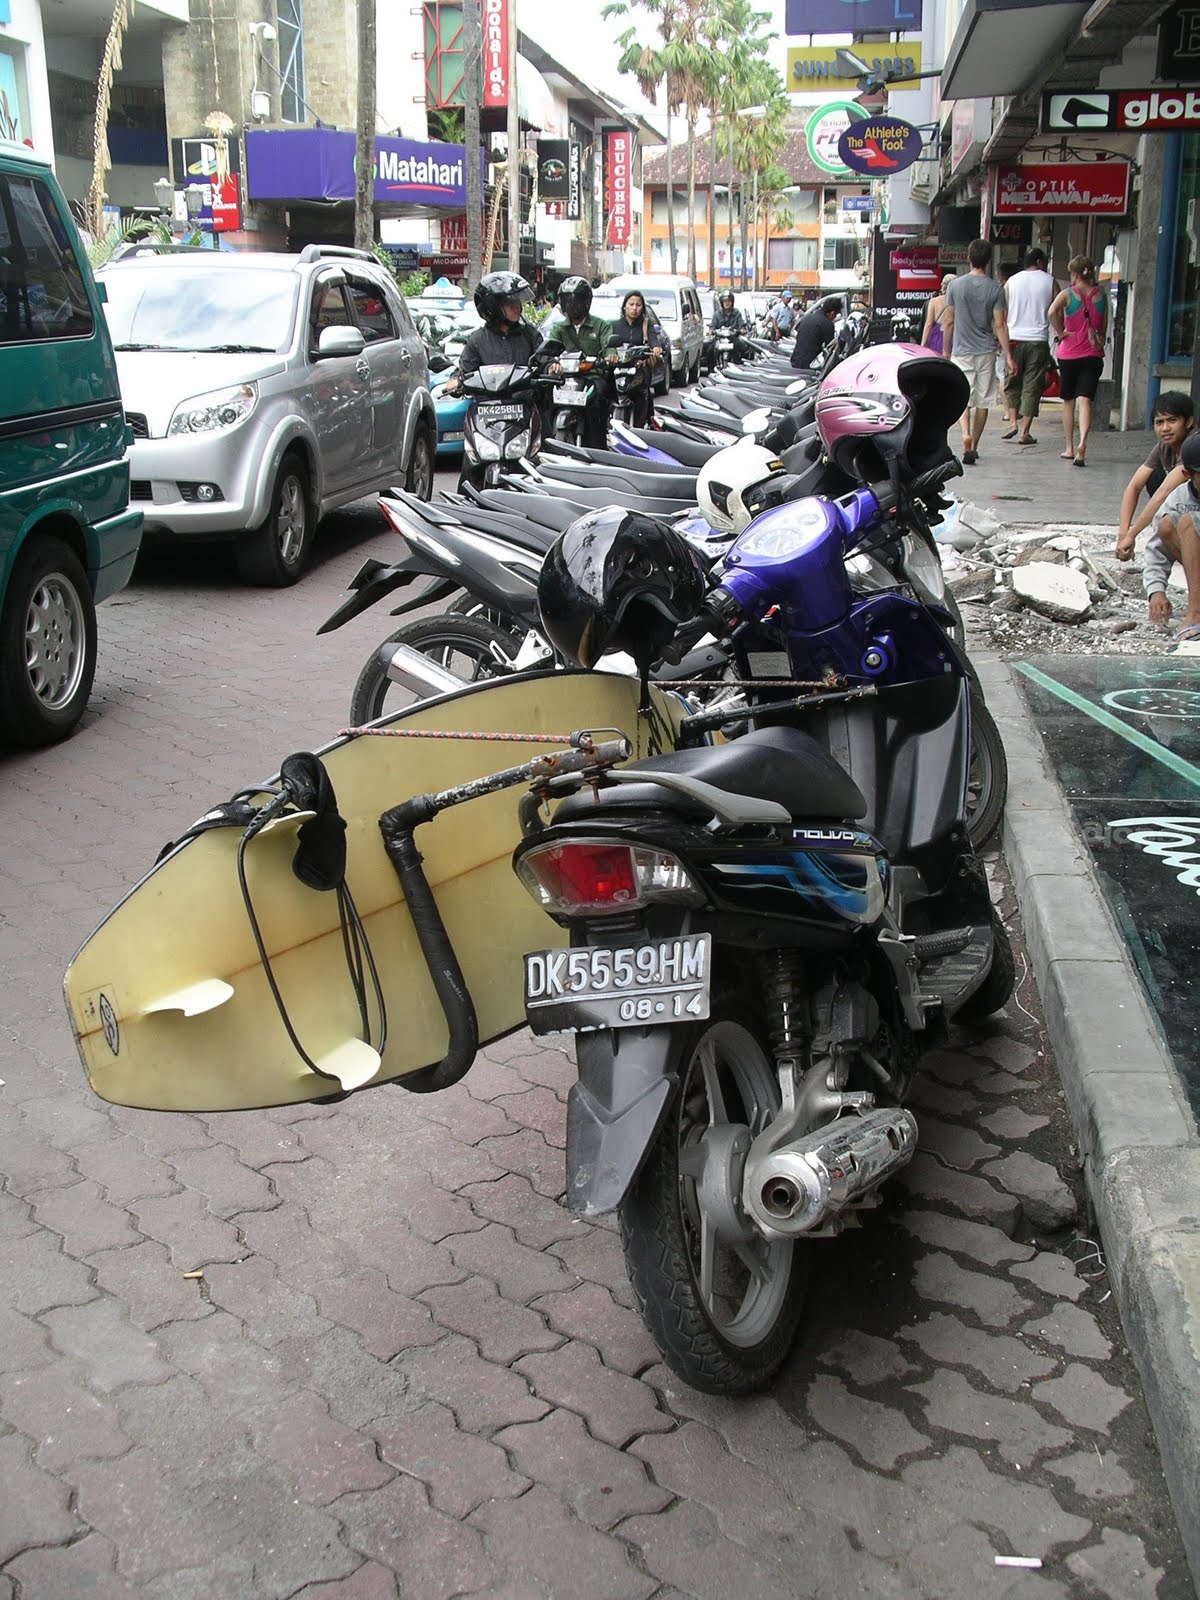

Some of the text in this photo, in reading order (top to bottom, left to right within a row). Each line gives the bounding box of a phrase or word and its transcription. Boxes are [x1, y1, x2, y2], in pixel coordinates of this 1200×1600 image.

[793, 56, 915, 79] SUNSSES
[847, 126, 909, 148] The Athlete's
[882, 139, 904, 151] Foot
[380, 151, 463, 186] Matahari
[614, 139, 626, 239] BUCCHERI
[1026, 180, 1076, 191] OPTIK
[1001, 191, 1123, 206] MELAWAI gallery
[876, 307, 923, 316] RE-OPENIN
